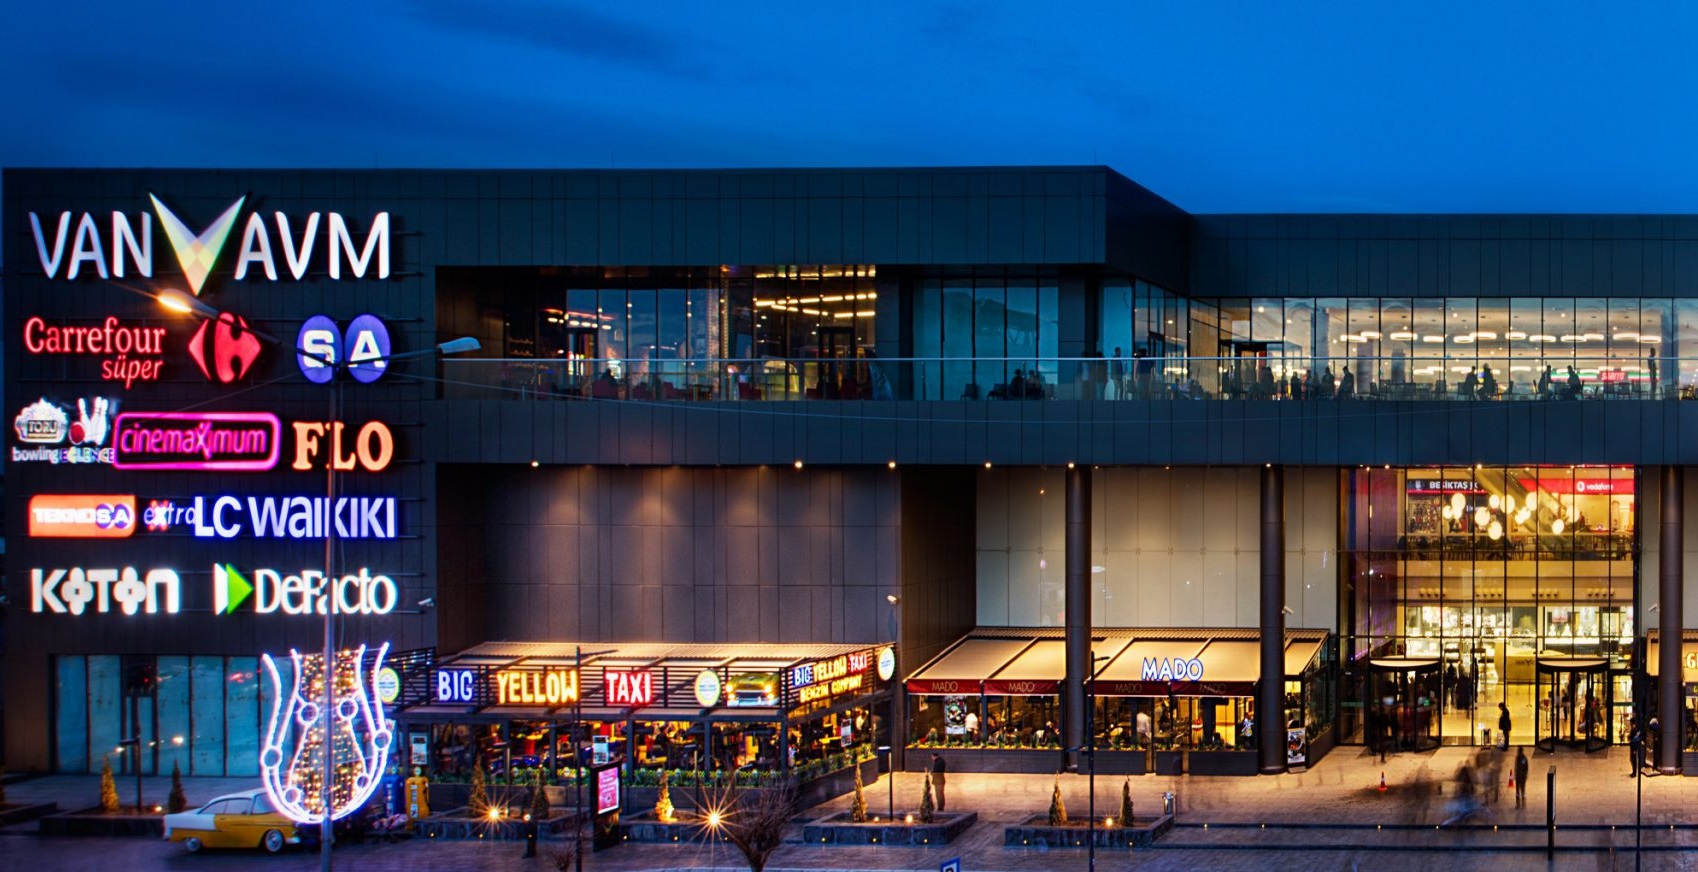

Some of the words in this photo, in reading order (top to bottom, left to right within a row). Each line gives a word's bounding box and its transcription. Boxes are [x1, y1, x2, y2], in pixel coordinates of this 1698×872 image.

[28, 211, 152, 280] VAN
[235, 211, 390, 280] AVM
[24, 316, 165, 354] Carrefour
[102, 356, 162, 389] süper
[12, 445, 59, 464] bowling
[292, 421, 394, 471] FLO
[32, 505, 132, 526] TEKNOSA
[195, 496, 242, 538] LC
[254, 567, 398, 615] DeFacto
[794, 666, 812, 687] BIG
[813, 655, 847, 683] YELLOW
[848, 654, 867, 672] TAXI
[1141, 657, 1204, 681] MADO
[438, 670, 473, 701] BIG
[497, 670, 578, 704] YELLOW
[605, 671, 651, 703] TAXI
[831, 675, 863, 694] COMPANY
[931, 681, 959, 692] MADO
[1008, 681, 1036, 693] MADO
[1115, 683, 1143, 694] MADO
[1200, 683, 1227, 694] MADO
